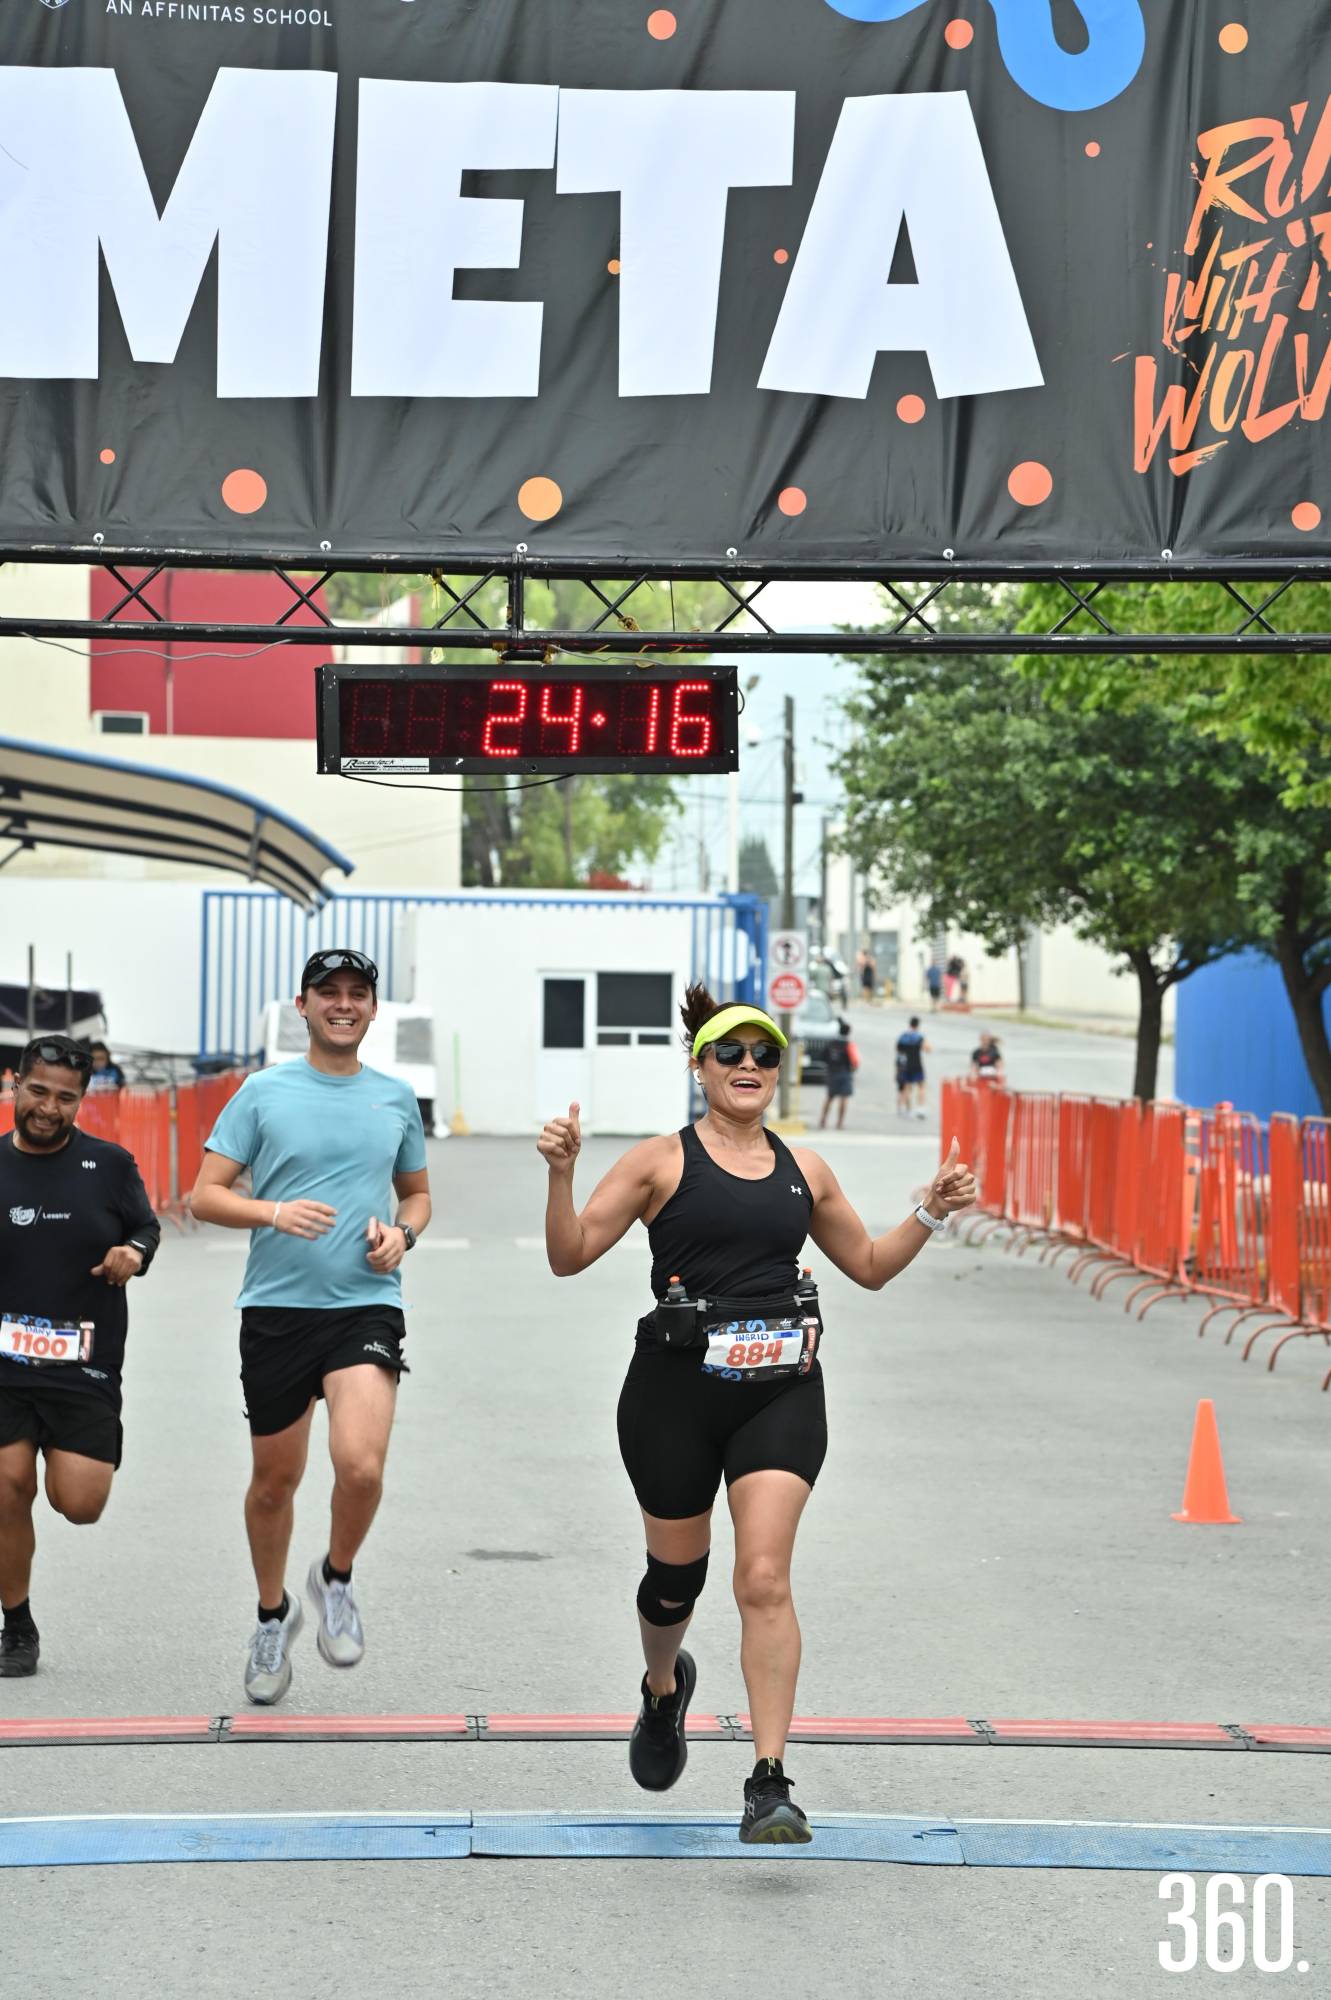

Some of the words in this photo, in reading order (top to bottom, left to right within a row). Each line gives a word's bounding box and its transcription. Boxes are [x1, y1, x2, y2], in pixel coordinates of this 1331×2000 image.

[106, 0, 133, 16] AN
[141, 1, 246, 23] AFFINITAS
[253, 8, 333, 27] SCHOOL
[1184, 94, 1331, 256] RU
[0, 67, 1045, 400] META
[1162, 226, 1291, 342] WITH
[12, 1331, 68, 1358] 1100
[735, 1332, 770, 1342] INGRID
[726, 1339, 784, 1367] 884
